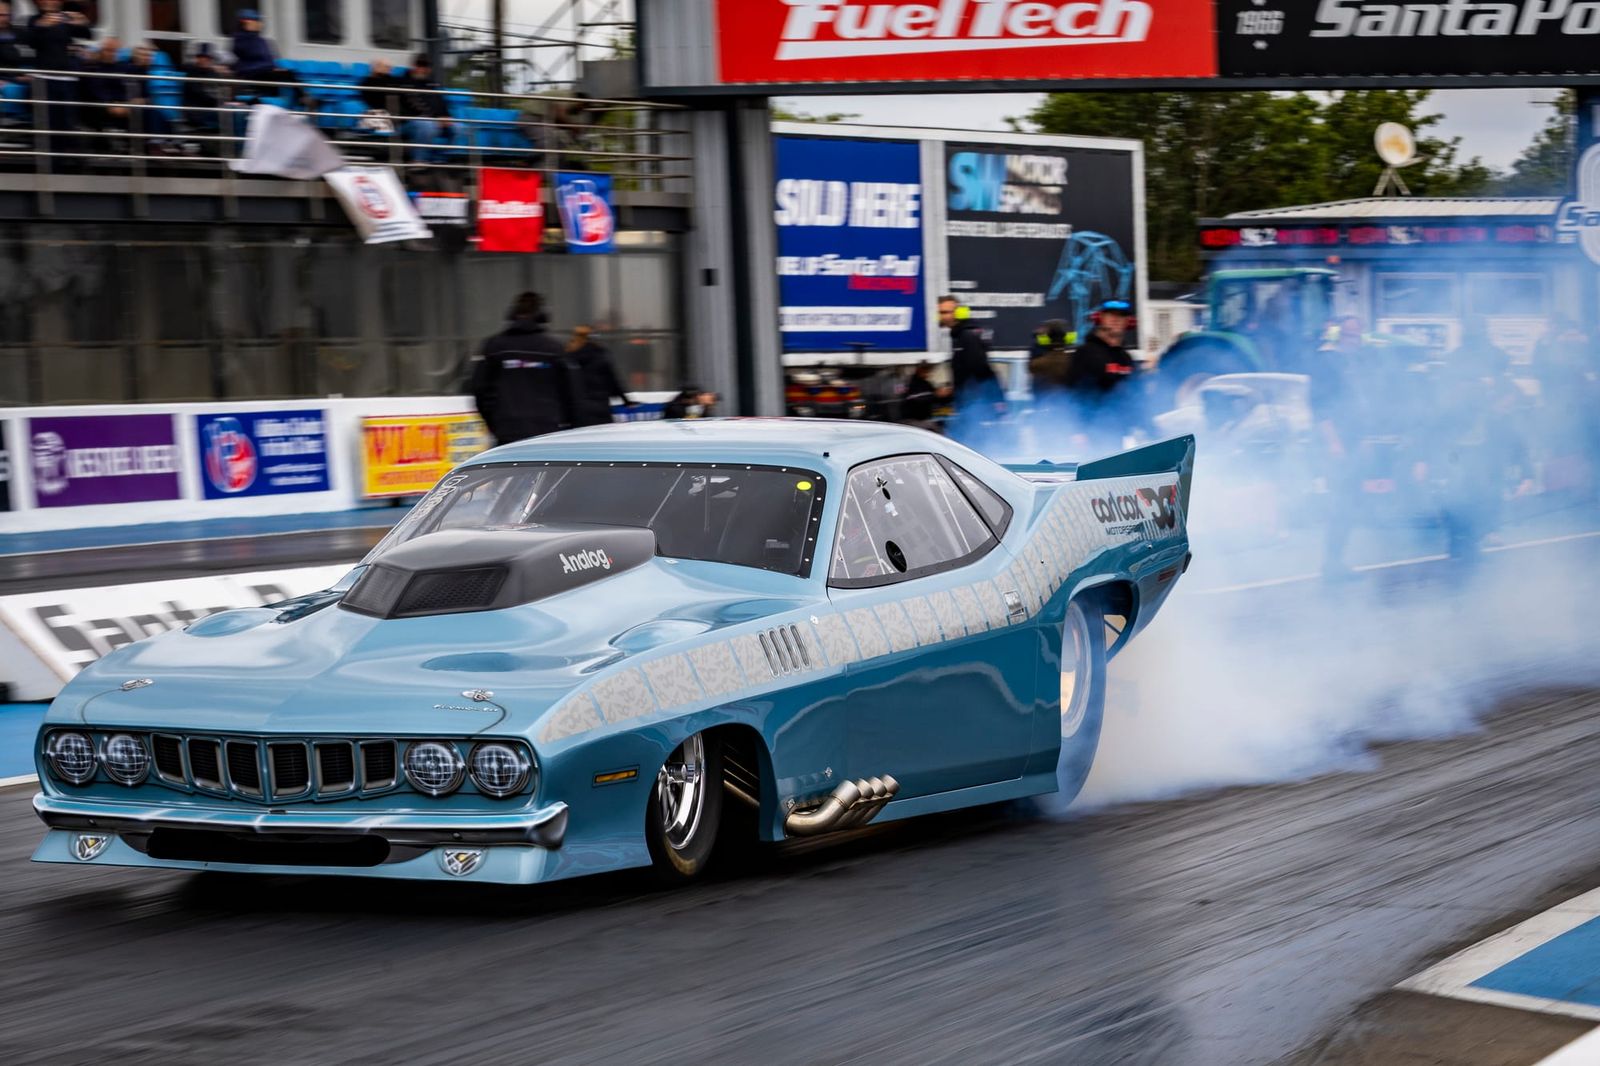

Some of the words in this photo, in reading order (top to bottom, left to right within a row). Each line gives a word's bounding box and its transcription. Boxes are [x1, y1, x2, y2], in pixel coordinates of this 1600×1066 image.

[779, 0, 1152, 41] FuelTech
[775, 178, 848, 227] SOLD
[848, 181, 920, 229] HERE
